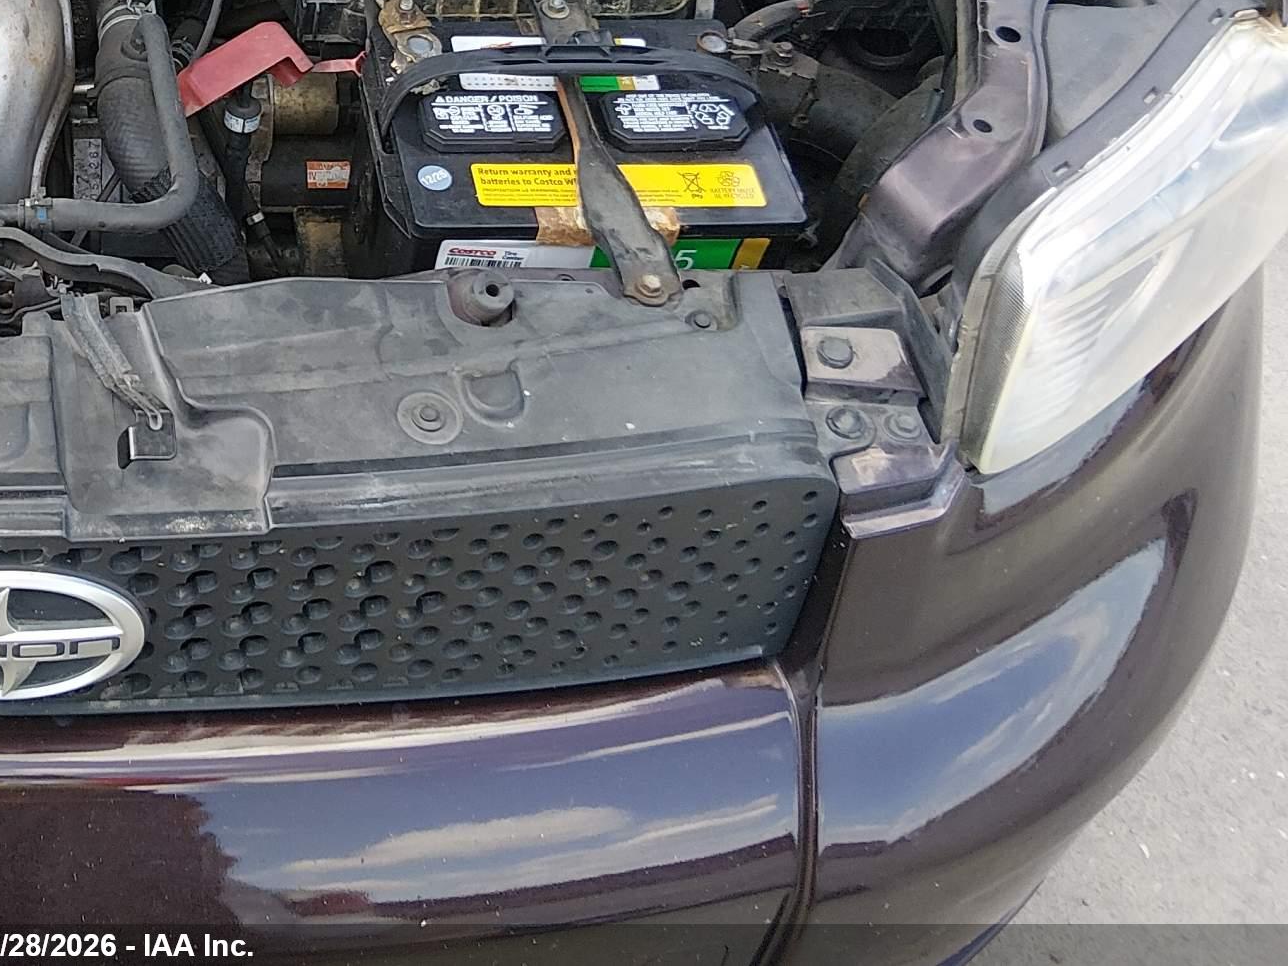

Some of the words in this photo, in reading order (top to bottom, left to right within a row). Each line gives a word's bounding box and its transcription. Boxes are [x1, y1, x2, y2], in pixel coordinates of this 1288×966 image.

[446, 95, 488, 103] DANGER
[478, 167, 509, 176] Return
[511, 168, 552, 178] warranty
[553, 168, 570, 176] and
[480, 177, 521, 186] batteries
[522, 178, 532, 186] to
[533, 177, 563, 186] Costco
[447, 247, 497, 256] COSTCO
